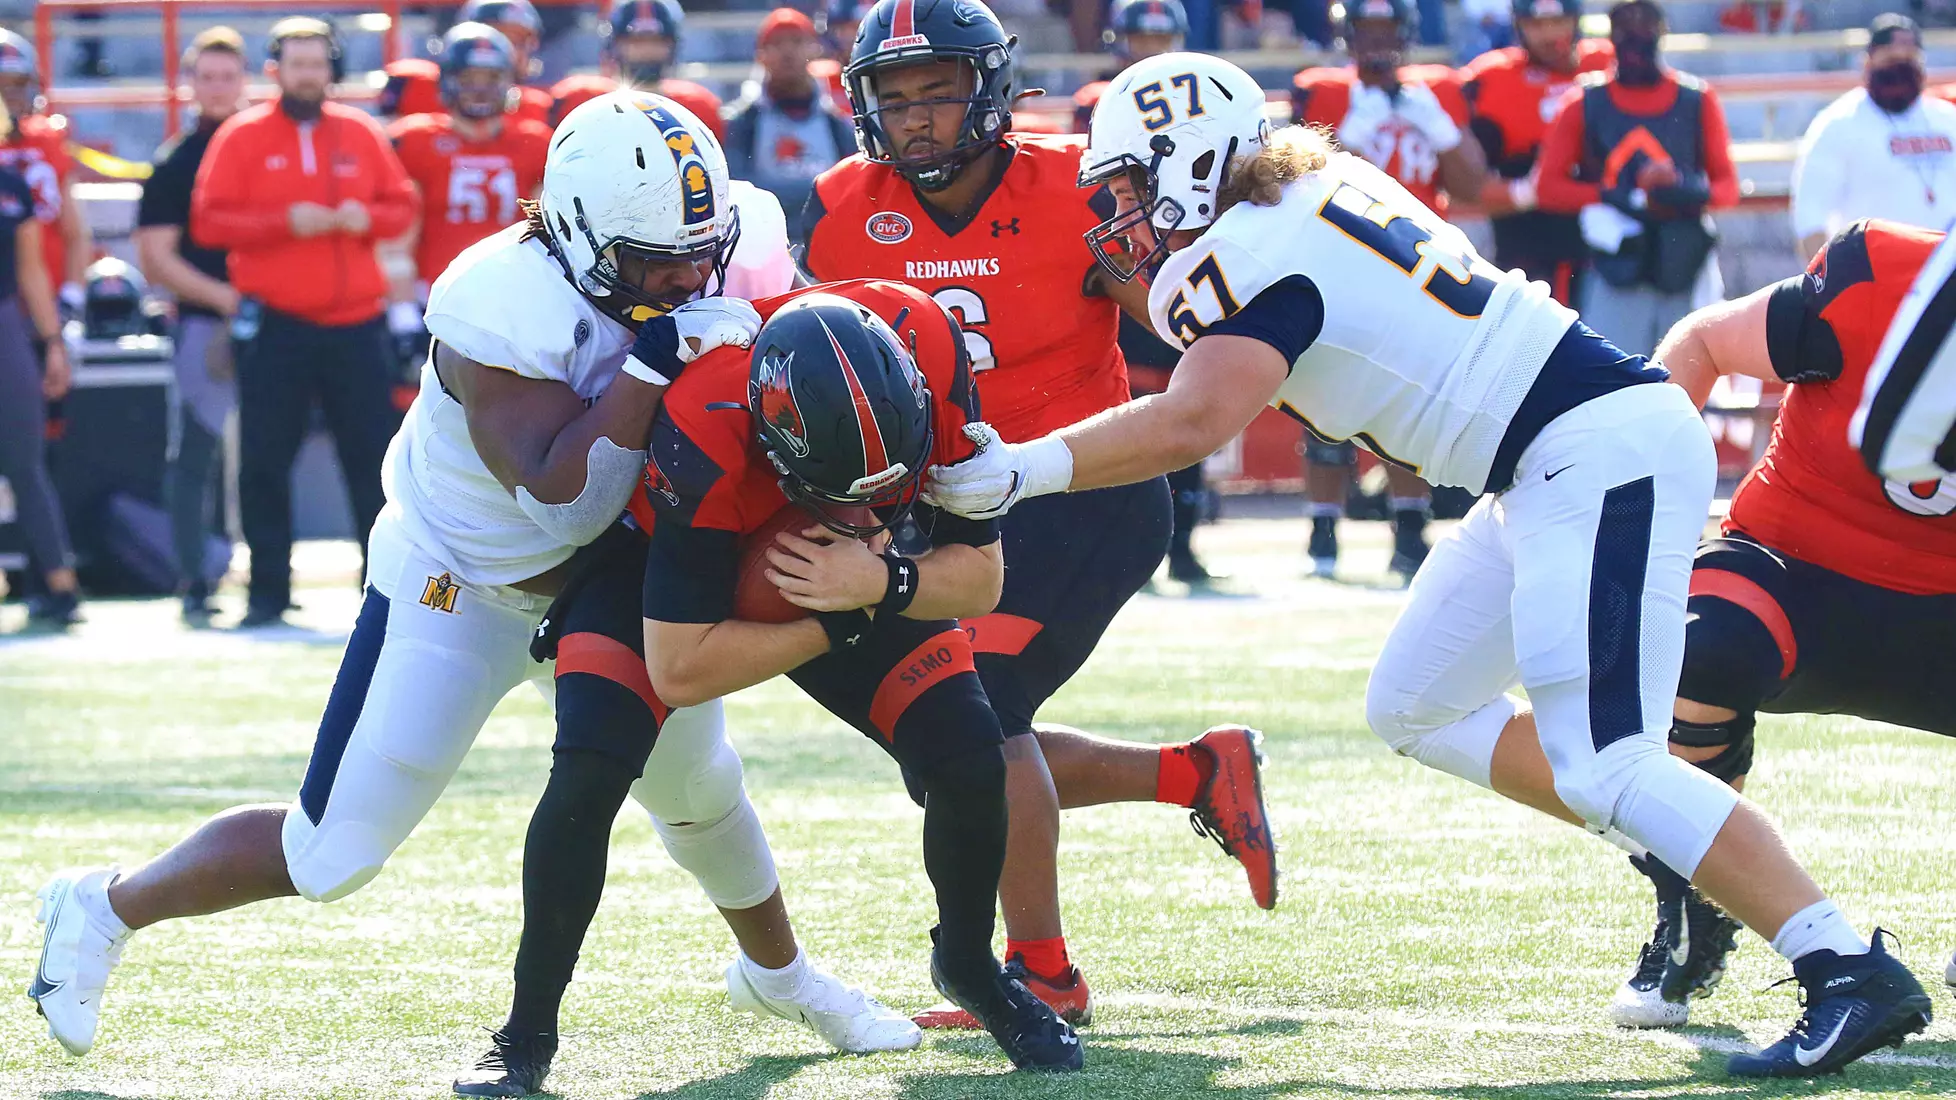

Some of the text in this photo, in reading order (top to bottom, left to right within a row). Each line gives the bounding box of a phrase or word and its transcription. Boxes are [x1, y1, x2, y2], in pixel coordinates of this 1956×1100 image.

[883, 36, 923, 49] REDHAWKS
[1132, 72, 1206, 132] 57
[447, 167, 518, 226] 51
[599, 257, 618, 279] Ridd
[906, 257, 1000, 279] REDHAWKS
[1167, 250, 1243, 350] 57
[860, 470, 900, 490] REDHAWKS
[900, 647, 953, 687] SEMO
